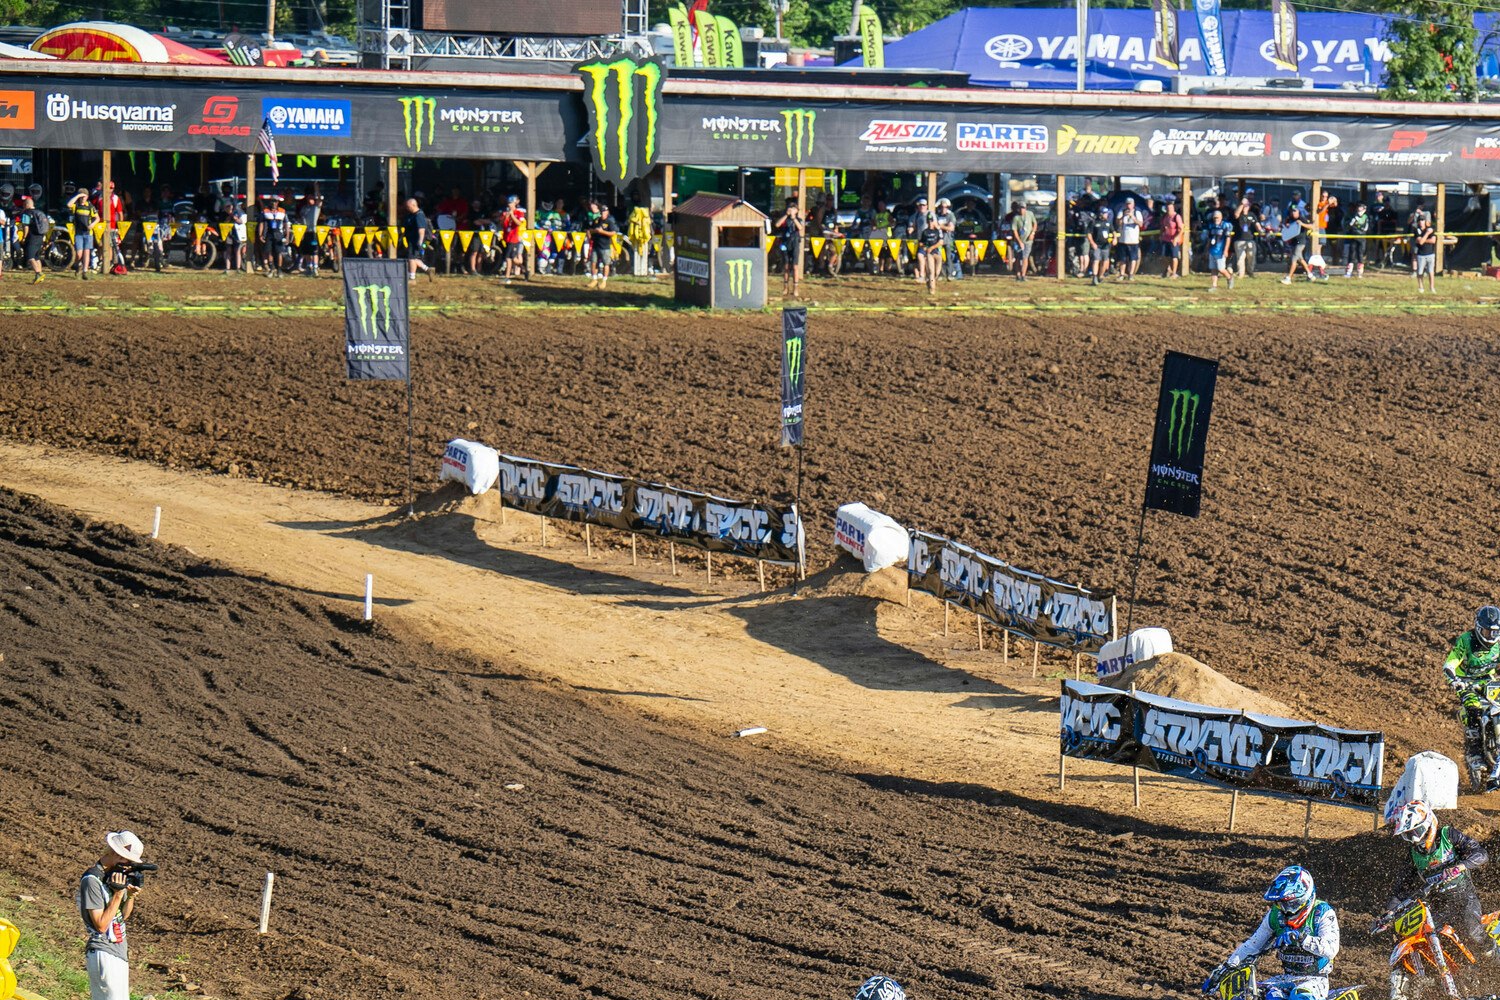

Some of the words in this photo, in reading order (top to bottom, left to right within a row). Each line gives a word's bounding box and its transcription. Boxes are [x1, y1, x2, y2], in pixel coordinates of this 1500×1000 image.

[1038, 34, 1201, 62] YAMAA
[72, 101, 173, 122] Husqvarna
[286, 107, 345, 125] YAMAHA
[441, 107, 524, 124] MONSTER
[123, 123, 173, 132] MOTORCYCLES
[188, 124, 251, 136] GASGAS
[702, 116, 782, 133] MONSTER
[870, 121, 945, 140] AMSOIL
[958, 124, 1046, 140] PARTS
[1168, 129, 1203, 140] ROCKY
[1205, 130, 1266, 142] MOUNTAIN
[959, 140, 1046, 150] UNLIMITED
[1076, 134, 1140, 155] THOR
[1280, 151, 1352, 163] OAKLEY
[1362, 152, 1448, 163] POLISPORT
[348, 343, 404, 355] MONSTER
[1152, 463, 1199, 485] MONSTER
[1141, 709, 1263, 768] STACYC
[1400, 906, 1424, 935] 45
